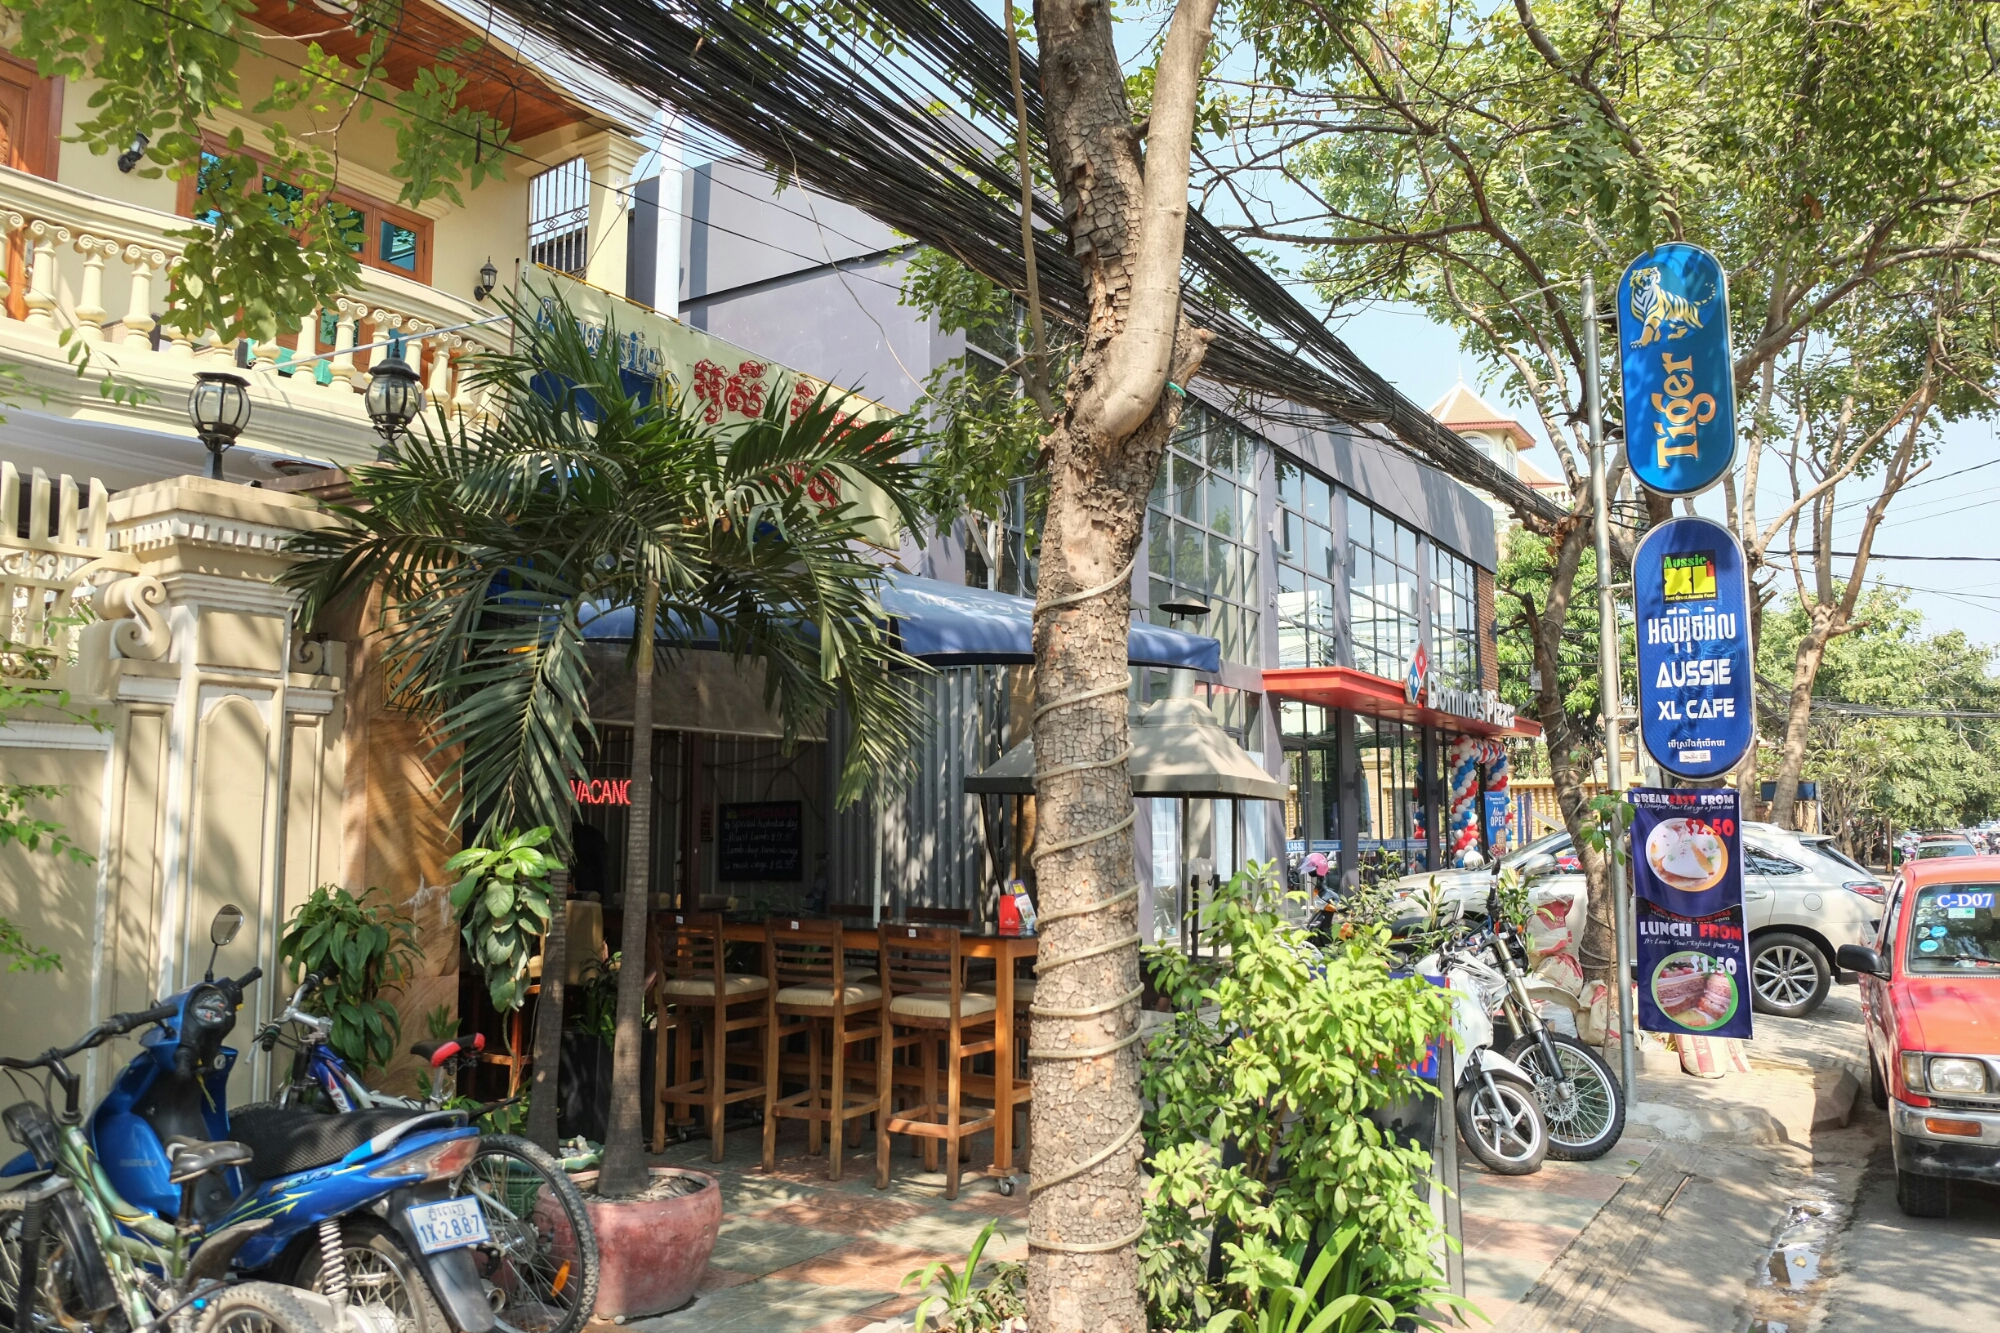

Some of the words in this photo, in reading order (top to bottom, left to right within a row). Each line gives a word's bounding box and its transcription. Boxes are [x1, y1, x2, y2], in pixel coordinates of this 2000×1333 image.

[1651, 352, 1716, 468] Tiger
[1663, 554, 1707, 569] Aussie
[1663, 566, 1716, 596] XL
[1656, 658, 1732, 688] AUSSIE
[1657, 700, 1682, 721] XL
[1685, 697, 1736, 719] CAFE
[570, 779, 632, 805] VACANC
[1633, 793, 1697, 805] BREAKFAST
[1700, 794, 1734, 805] FROM
[1685, 818, 1735, 837] $2.50
[1936, 893, 1993, 908] C-D07
[1640, 921, 1692, 937] LUNCH
[1699, 923, 1742, 940] FROM
[1690, 954, 1738, 975] $1.50
